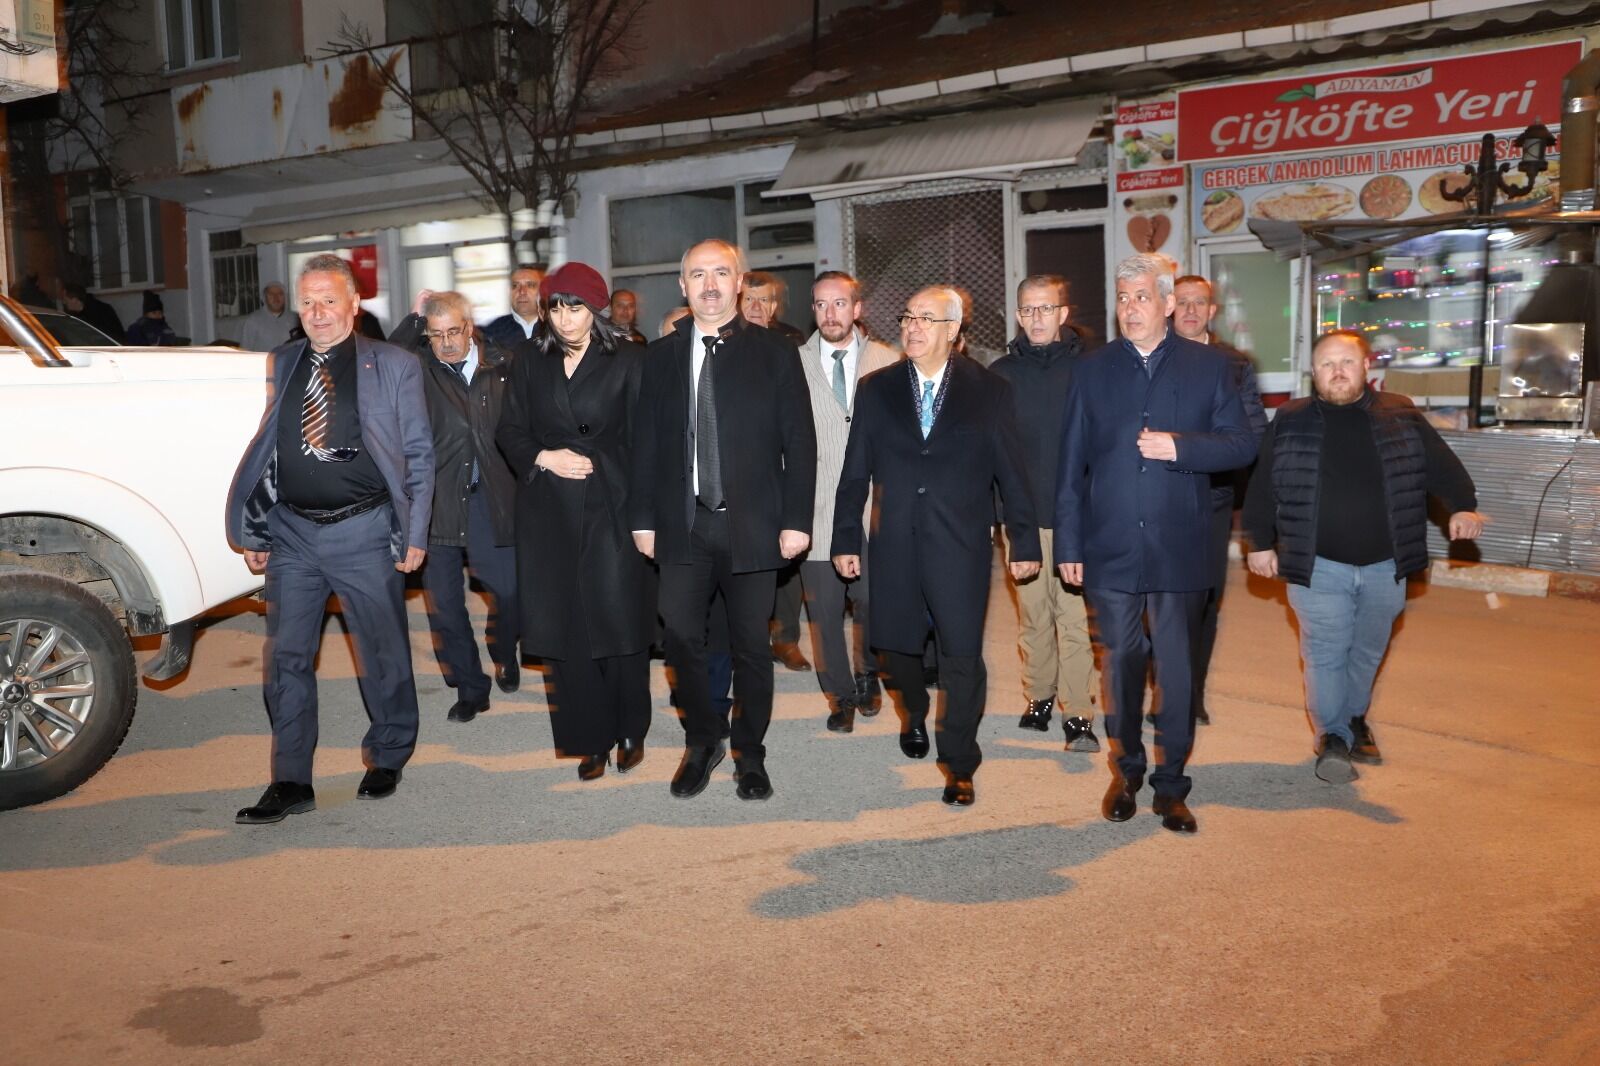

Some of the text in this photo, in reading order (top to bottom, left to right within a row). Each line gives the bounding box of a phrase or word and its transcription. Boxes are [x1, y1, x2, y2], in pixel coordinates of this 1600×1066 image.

[1325, 72, 1426, 93] ADIYAMAN
[1210, 80, 1537, 153] Çiğköfte Yeri
[1203, 164, 1270, 189] GERÇEK
[1273, 153, 1374, 182] ANADOLUM
